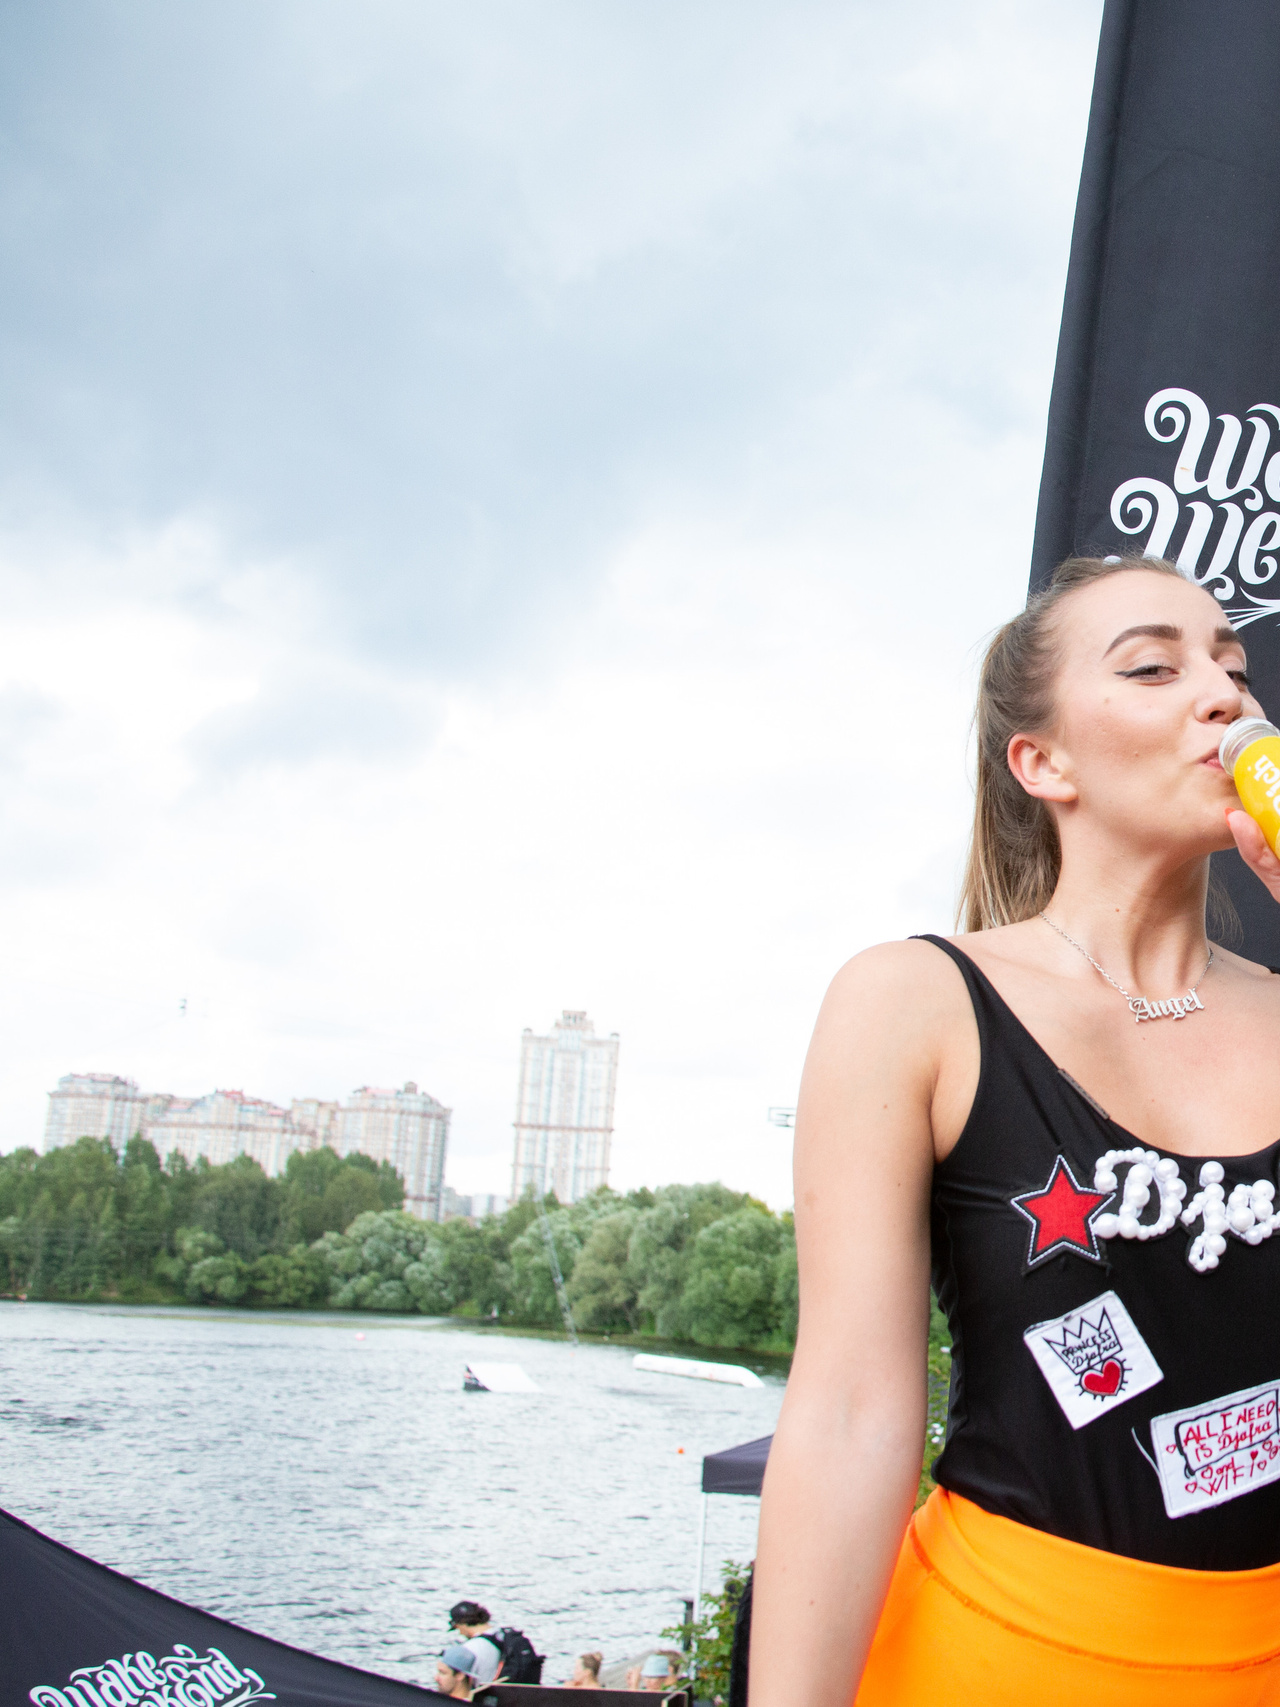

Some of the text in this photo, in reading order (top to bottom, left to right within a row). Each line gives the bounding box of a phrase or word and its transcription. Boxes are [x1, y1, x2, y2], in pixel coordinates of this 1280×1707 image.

[1131, 988, 1205, 1023] Angel
[1184, 1420, 1219, 1446] ALL
[1236, 1400, 1276, 1425] NEED
